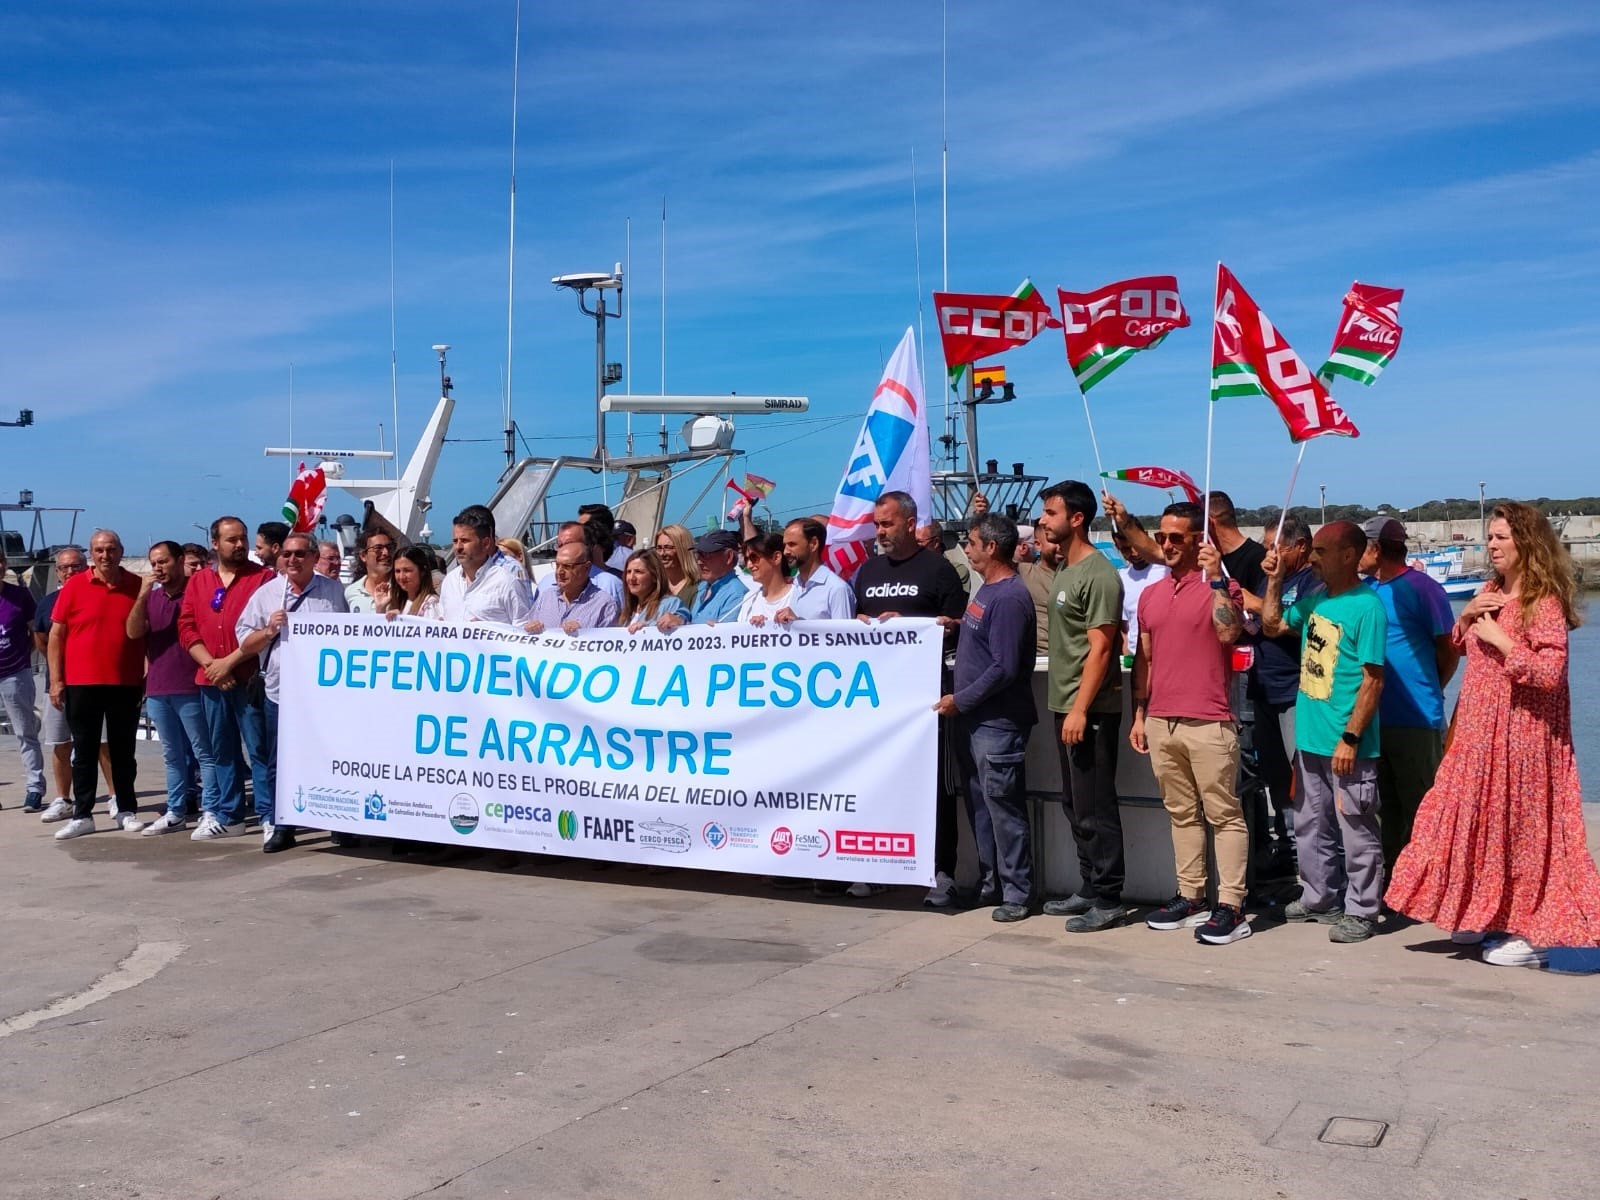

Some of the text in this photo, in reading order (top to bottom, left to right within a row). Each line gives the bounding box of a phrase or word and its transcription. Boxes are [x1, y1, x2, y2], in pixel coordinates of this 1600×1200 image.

[764, 399, 802, 409] SIMRAD
[866, 582, 919, 598] adidas
[292, 623, 340, 636] EUROPA
[344, 624, 360, 637] DE
[362, 624, 422, 638] MOVILIZA
[425, 626, 458, 639] PARA
[462, 628, 540, 646] DEFENDER
[544, 638, 566, 649] SU
[641, 638, 683, 651] MAYO
[688, 636, 726, 650] 2023.
[731, 635, 792, 648] PUERTO
[798, 633, 820, 647] DE
[825, 628, 923, 646] SANLÚCAR.
[318, 648, 880, 708] DEFENDIENDO LA PESCA
[415, 714, 733, 775] DE ARRASTRE
[332, 760, 857, 813] PORQUE LA PESCA NO ES EL PROBLEMA DEL MEDIO AMBIENTE
[485, 803, 552, 823] cepesca
[583, 816, 635, 843] FAAPE
[708, 832, 722, 841] ETF
[795, 834, 820, 844] FeSMC
[840, 834, 910, 853] CCOO
